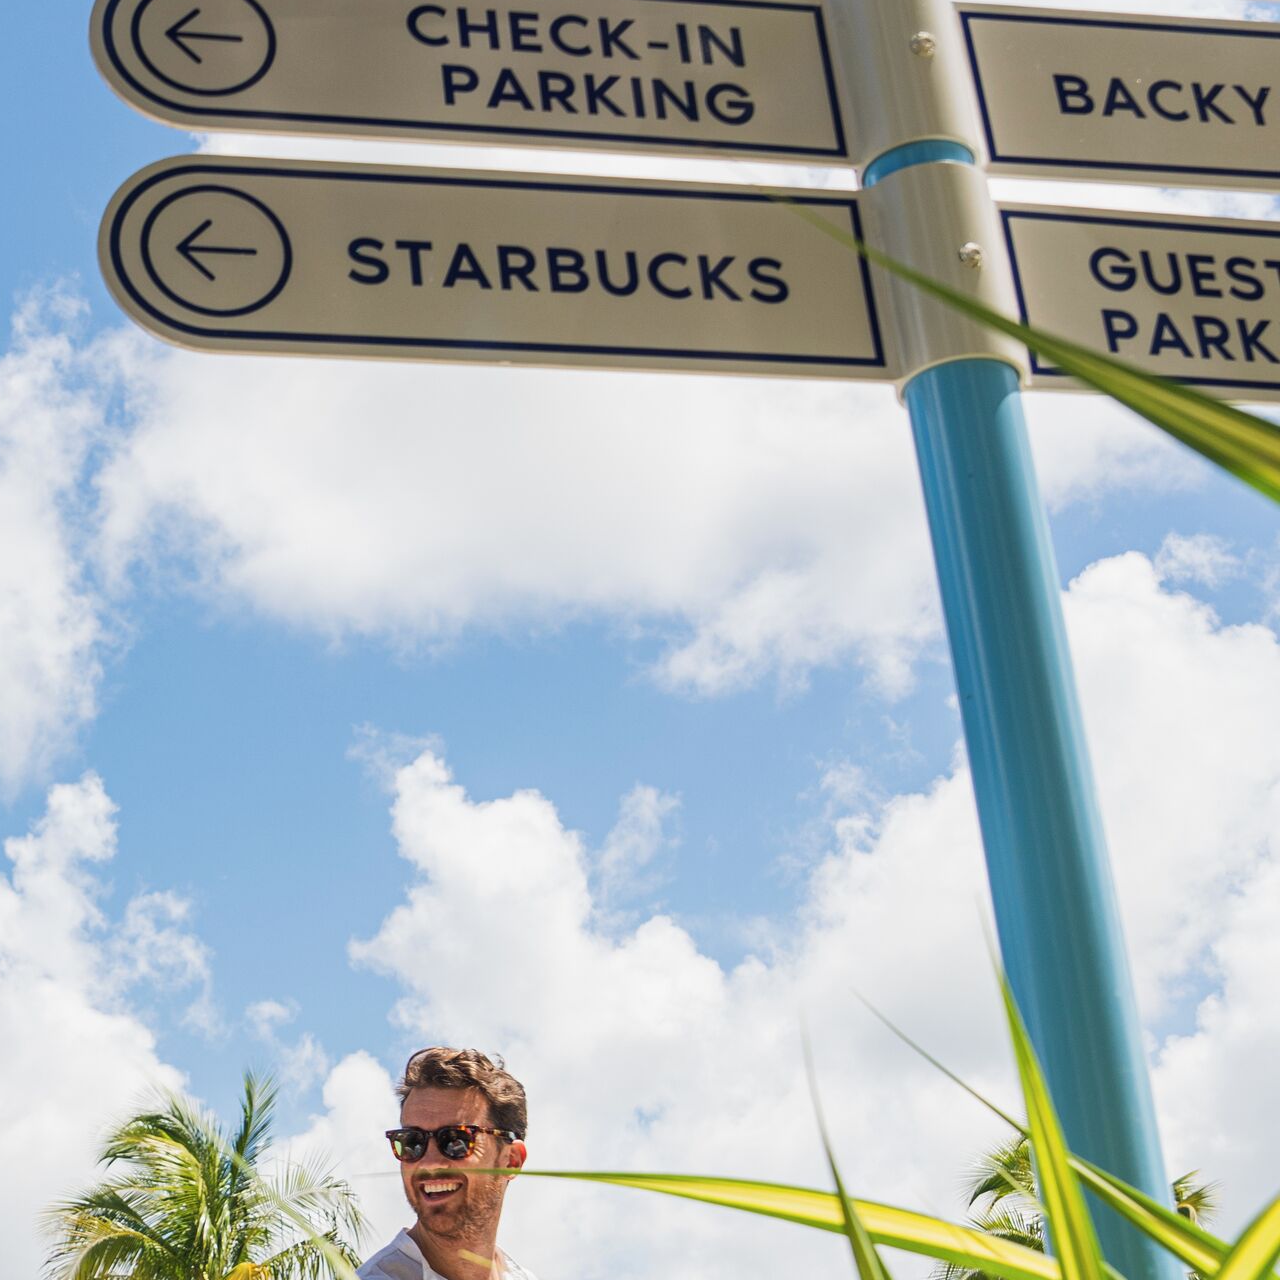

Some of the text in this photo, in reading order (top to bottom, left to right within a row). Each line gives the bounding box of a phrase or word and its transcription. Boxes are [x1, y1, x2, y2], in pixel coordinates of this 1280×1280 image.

[405, 3, 747, 69] CHECK-IN
[440, 63, 756, 127] PARKING
[1052, 73, 1271, 127] BACKY
[346, 236, 791, 305] STARBUCKS
[1101, 308, 1280, 365] PARK
